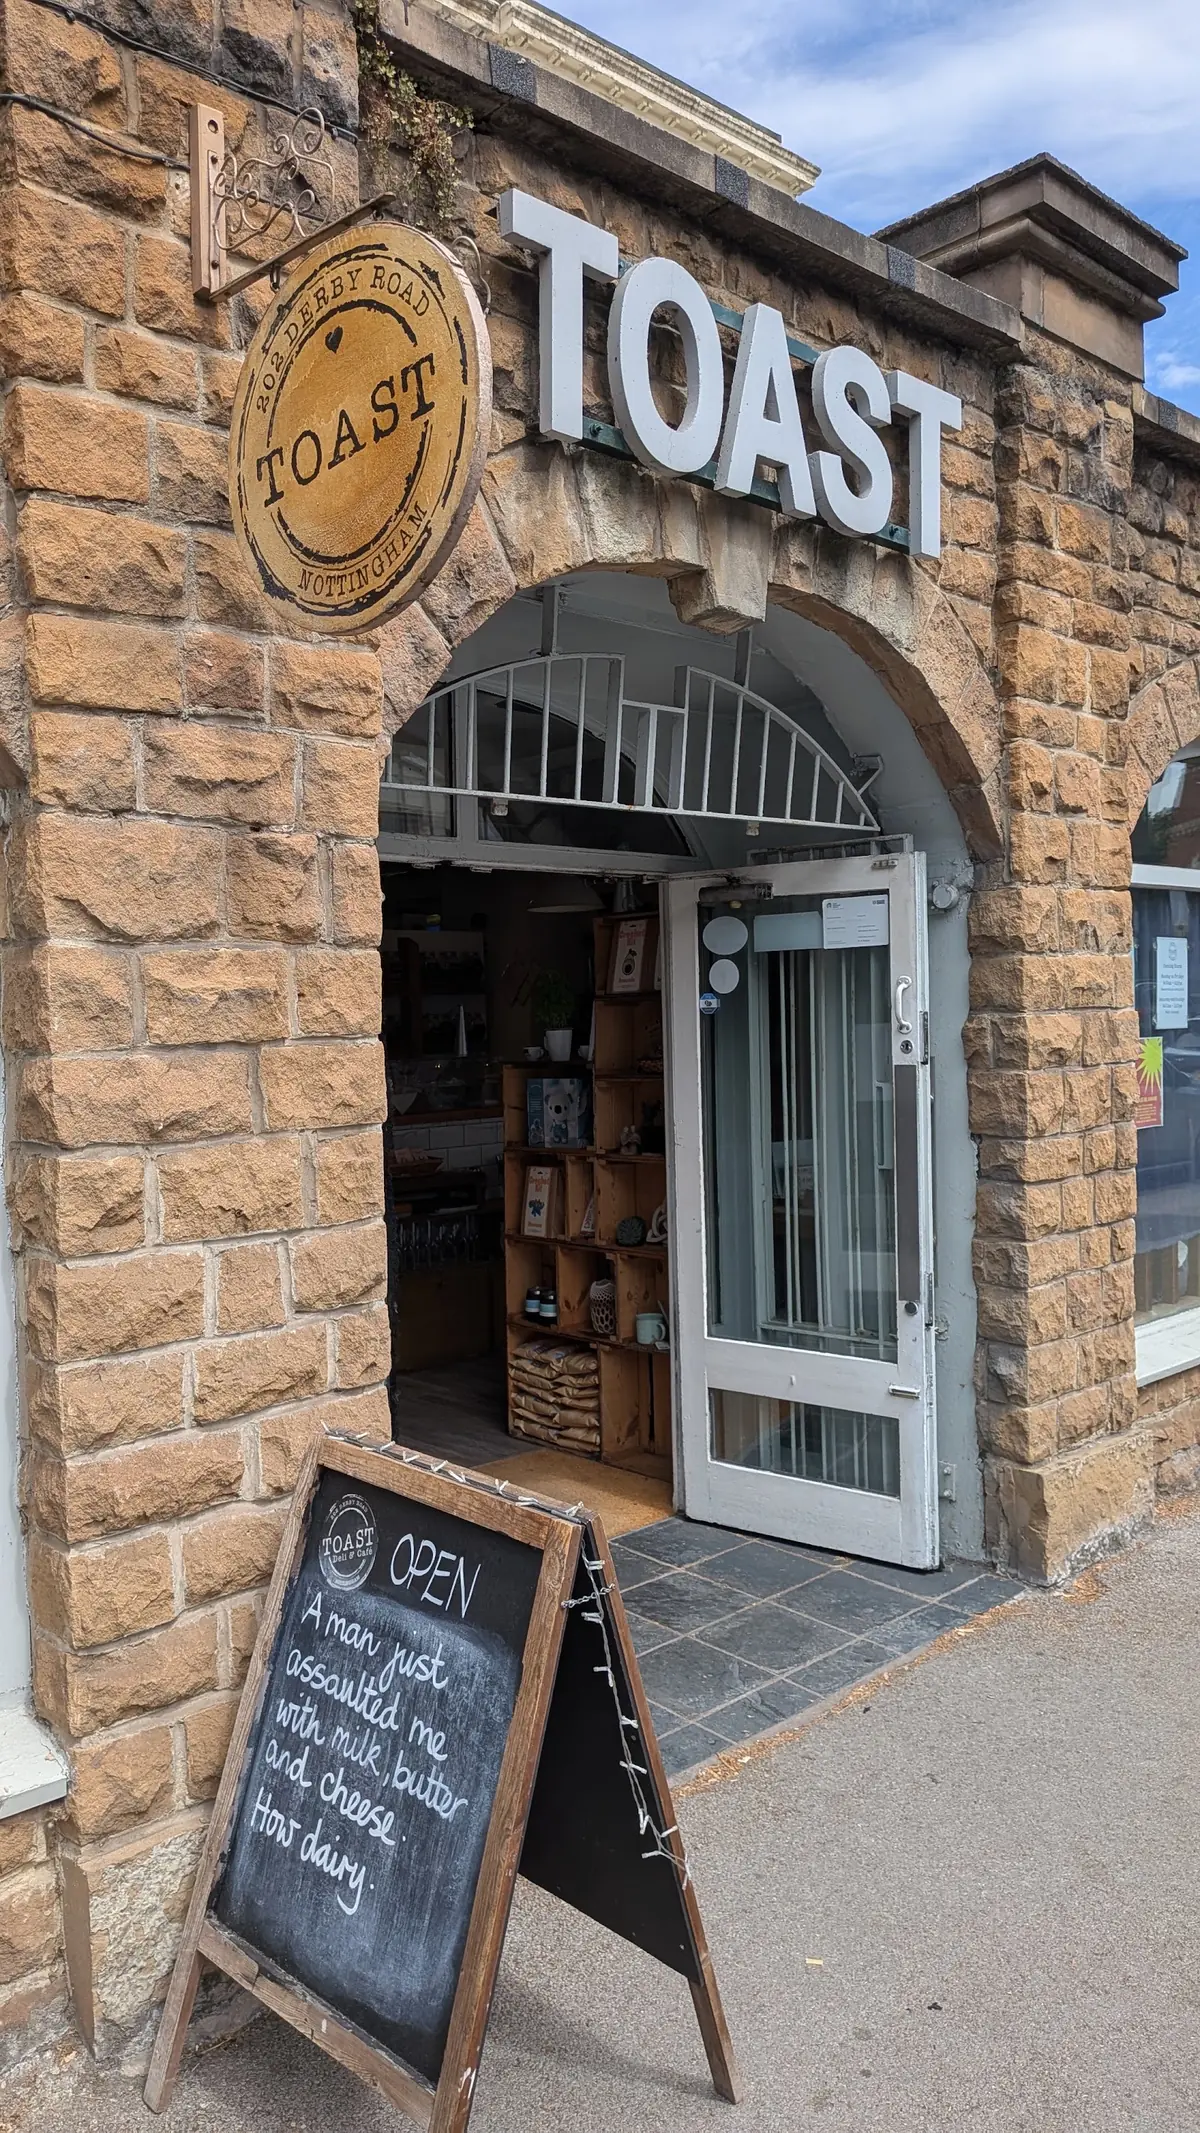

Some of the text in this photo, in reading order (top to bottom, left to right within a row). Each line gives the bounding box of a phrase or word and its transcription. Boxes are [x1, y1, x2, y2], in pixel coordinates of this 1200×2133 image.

[257, 265, 430, 414] 202 DERBY ROAD
[500, 188, 962, 559] TOAST
[256, 353, 435, 508] TOAST
[298, 500, 428, 598] NOTTINGHAM
[322, 1527, 374, 1556] TOAST
[332, 1546, 373, 1563] Deli & Café
[339, 1500, 355, 1511] DERBY
[356, 1500, 368, 1513] ROAD
[390, 1533, 481, 1618] OPEN
[301, 1592, 449, 1692] A man just
[276, 1692, 325, 1745] with
[285, 1648, 448, 1761] assaulted me
[264, 1737, 407, 1847] and cheese.
[250, 1785, 375, 1916] How dairy.
